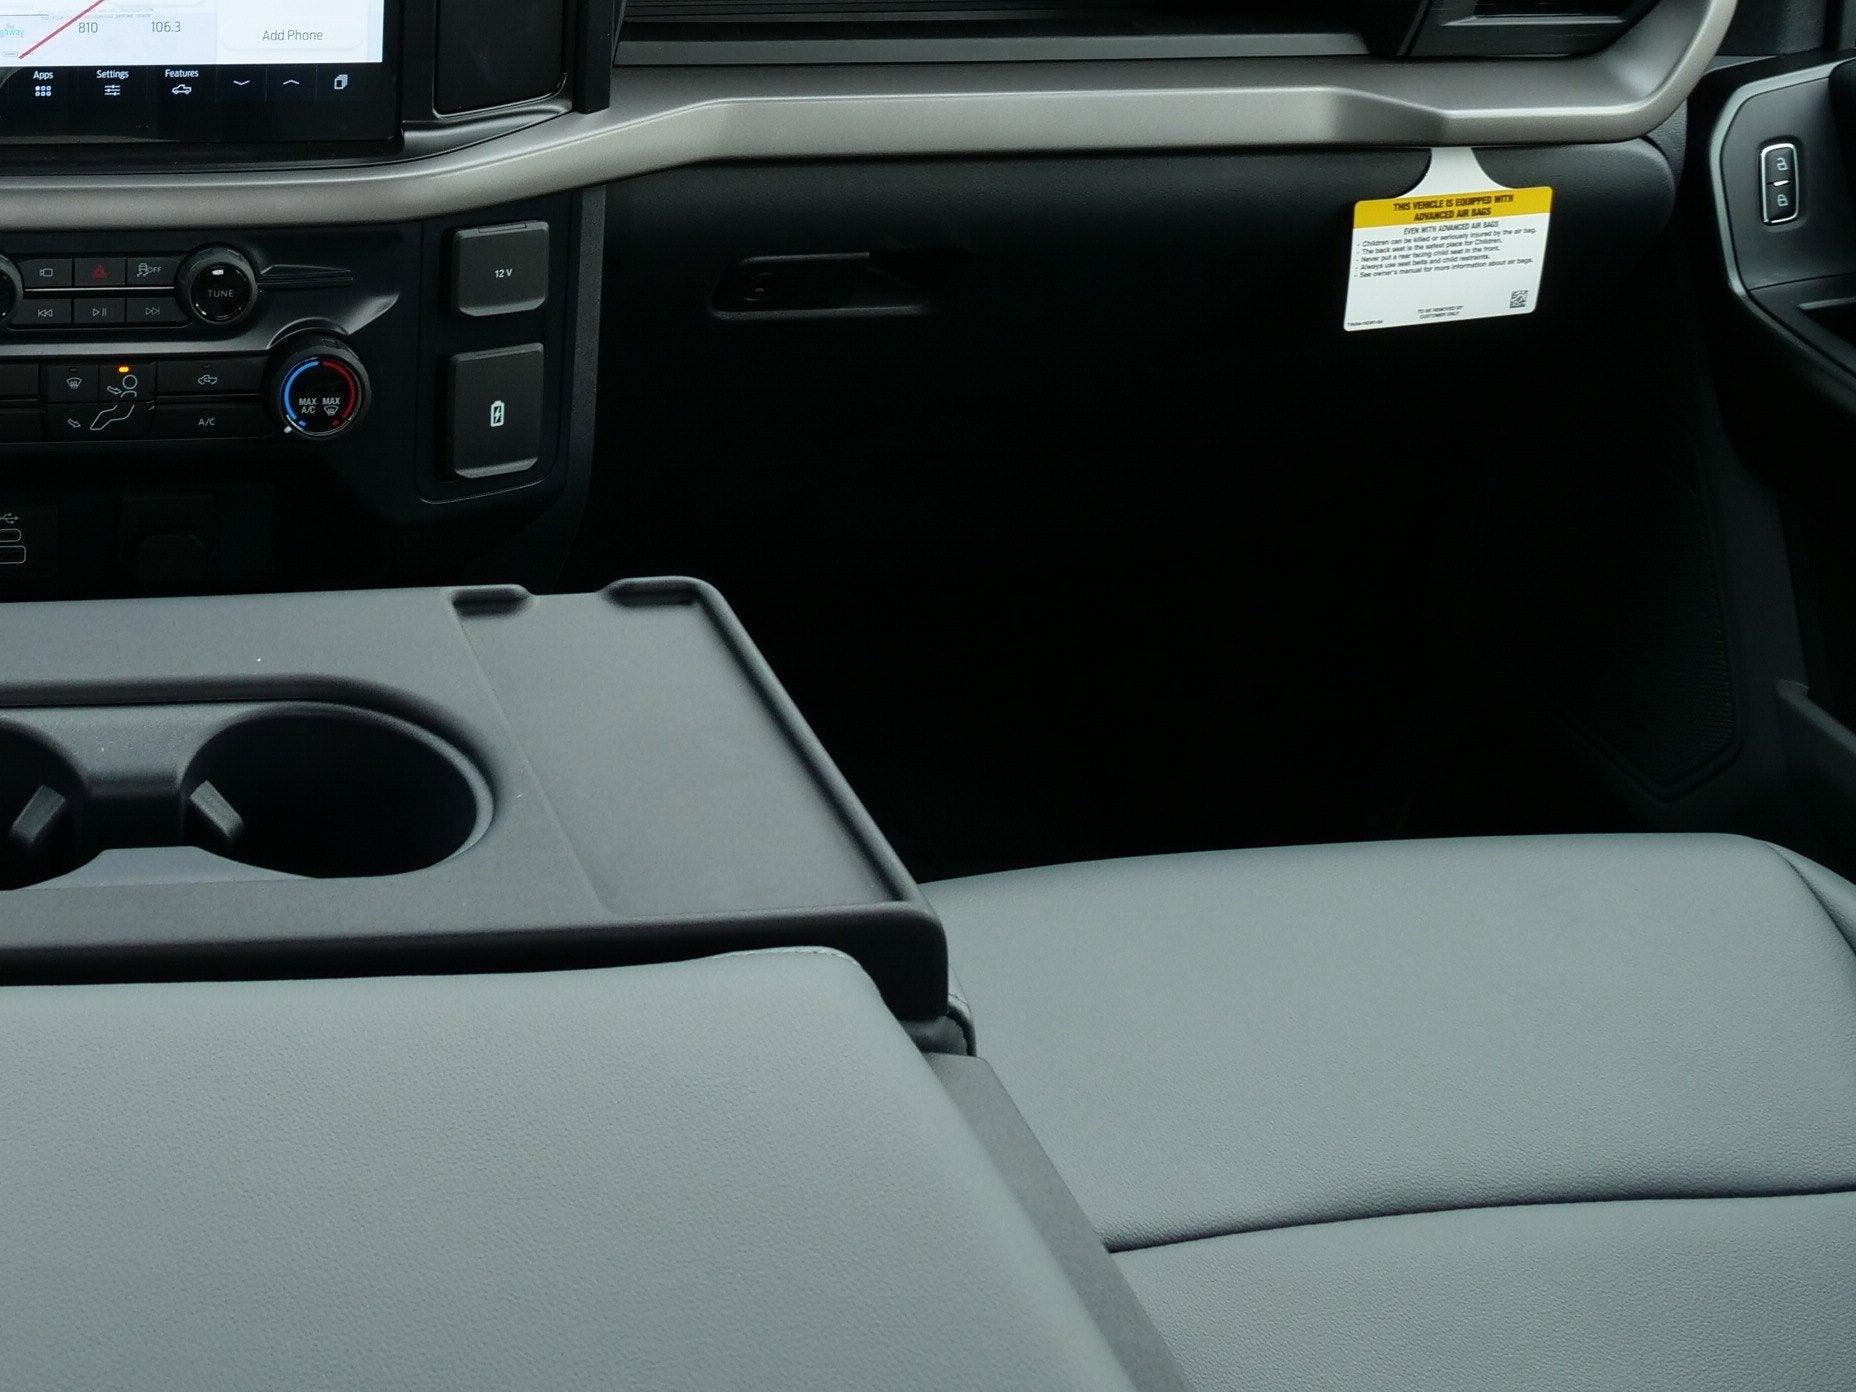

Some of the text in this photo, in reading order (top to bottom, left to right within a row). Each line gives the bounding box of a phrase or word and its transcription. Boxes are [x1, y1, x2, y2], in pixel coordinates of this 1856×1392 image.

[78, 22, 98, 34] 810
[151, 21, 181, 33] 106.3
[262, 30, 324, 41] Add Phone
[33, 71, 54, 81] Apps
[96, 70, 129, 79] Settings
[165, 69, 199, 78] Features
[1394, 194, 1514, 211] THIS VEHICLE IS EQUIPPED WITH
[1414, 208, 1491, 221] ADVANCED AIR BAGS
[1438, 223, 1469, 231] ADVANCED
[149, 266, 162, 274] OFF
[495, 269, 513, 278] 12 V
[207, 289, 234, 298] TUNE
[299, 397, 318, 406] MAX
[322, 397, 341, 405] MAX
[301, 405, 316, 414] A/C
[198, 417, 216, 427] A/C
